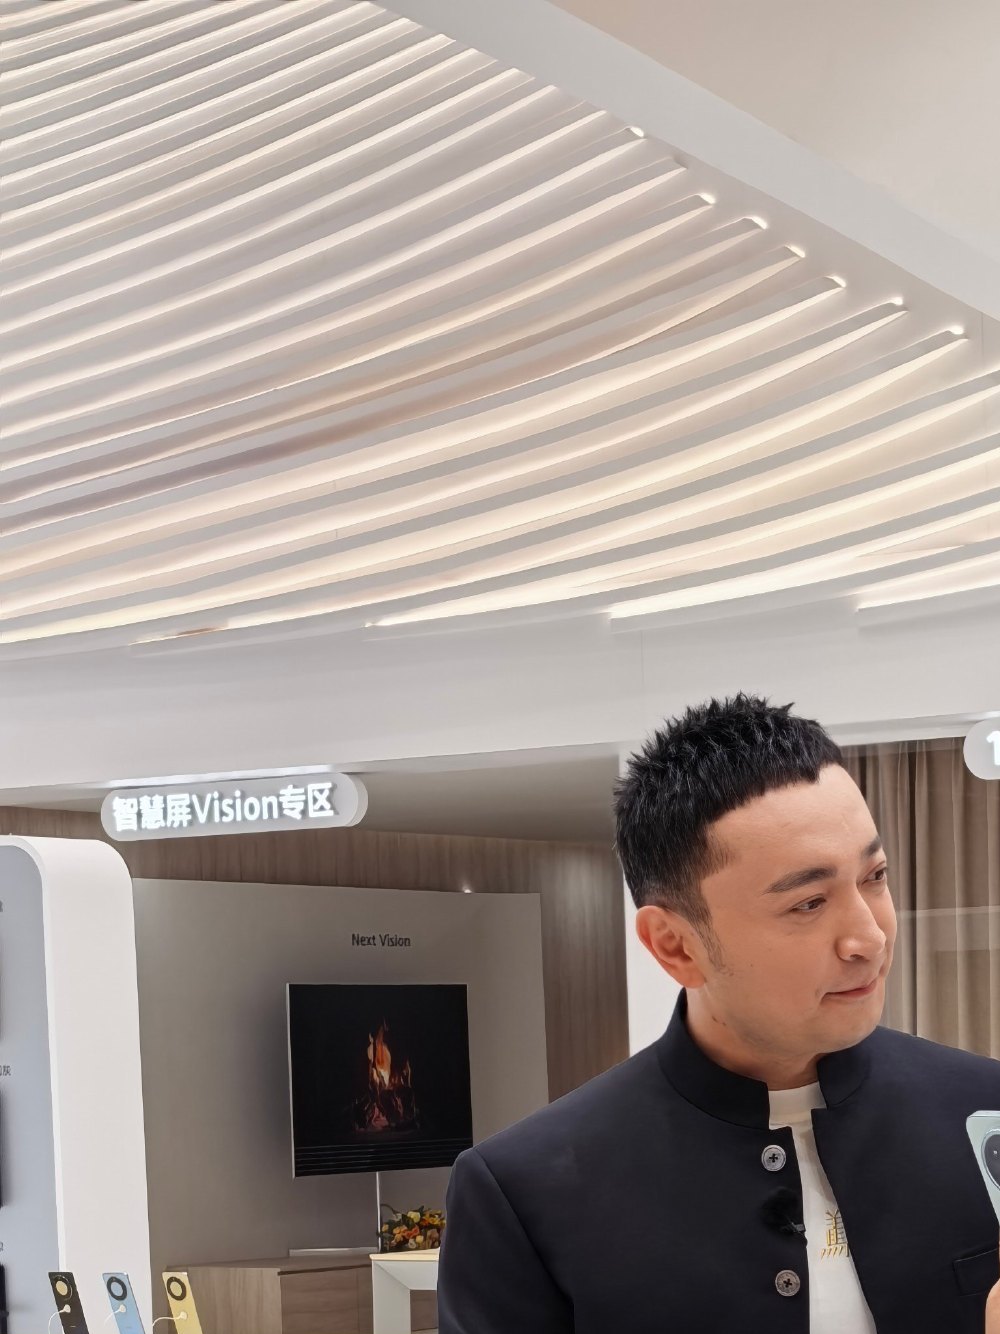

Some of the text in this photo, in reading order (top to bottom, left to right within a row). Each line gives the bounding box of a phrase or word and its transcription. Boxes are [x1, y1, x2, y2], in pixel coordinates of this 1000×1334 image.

[112, 782, 334, 832] 智慧屏Vision专区
[351, 933, 411, 947] Next Vision
